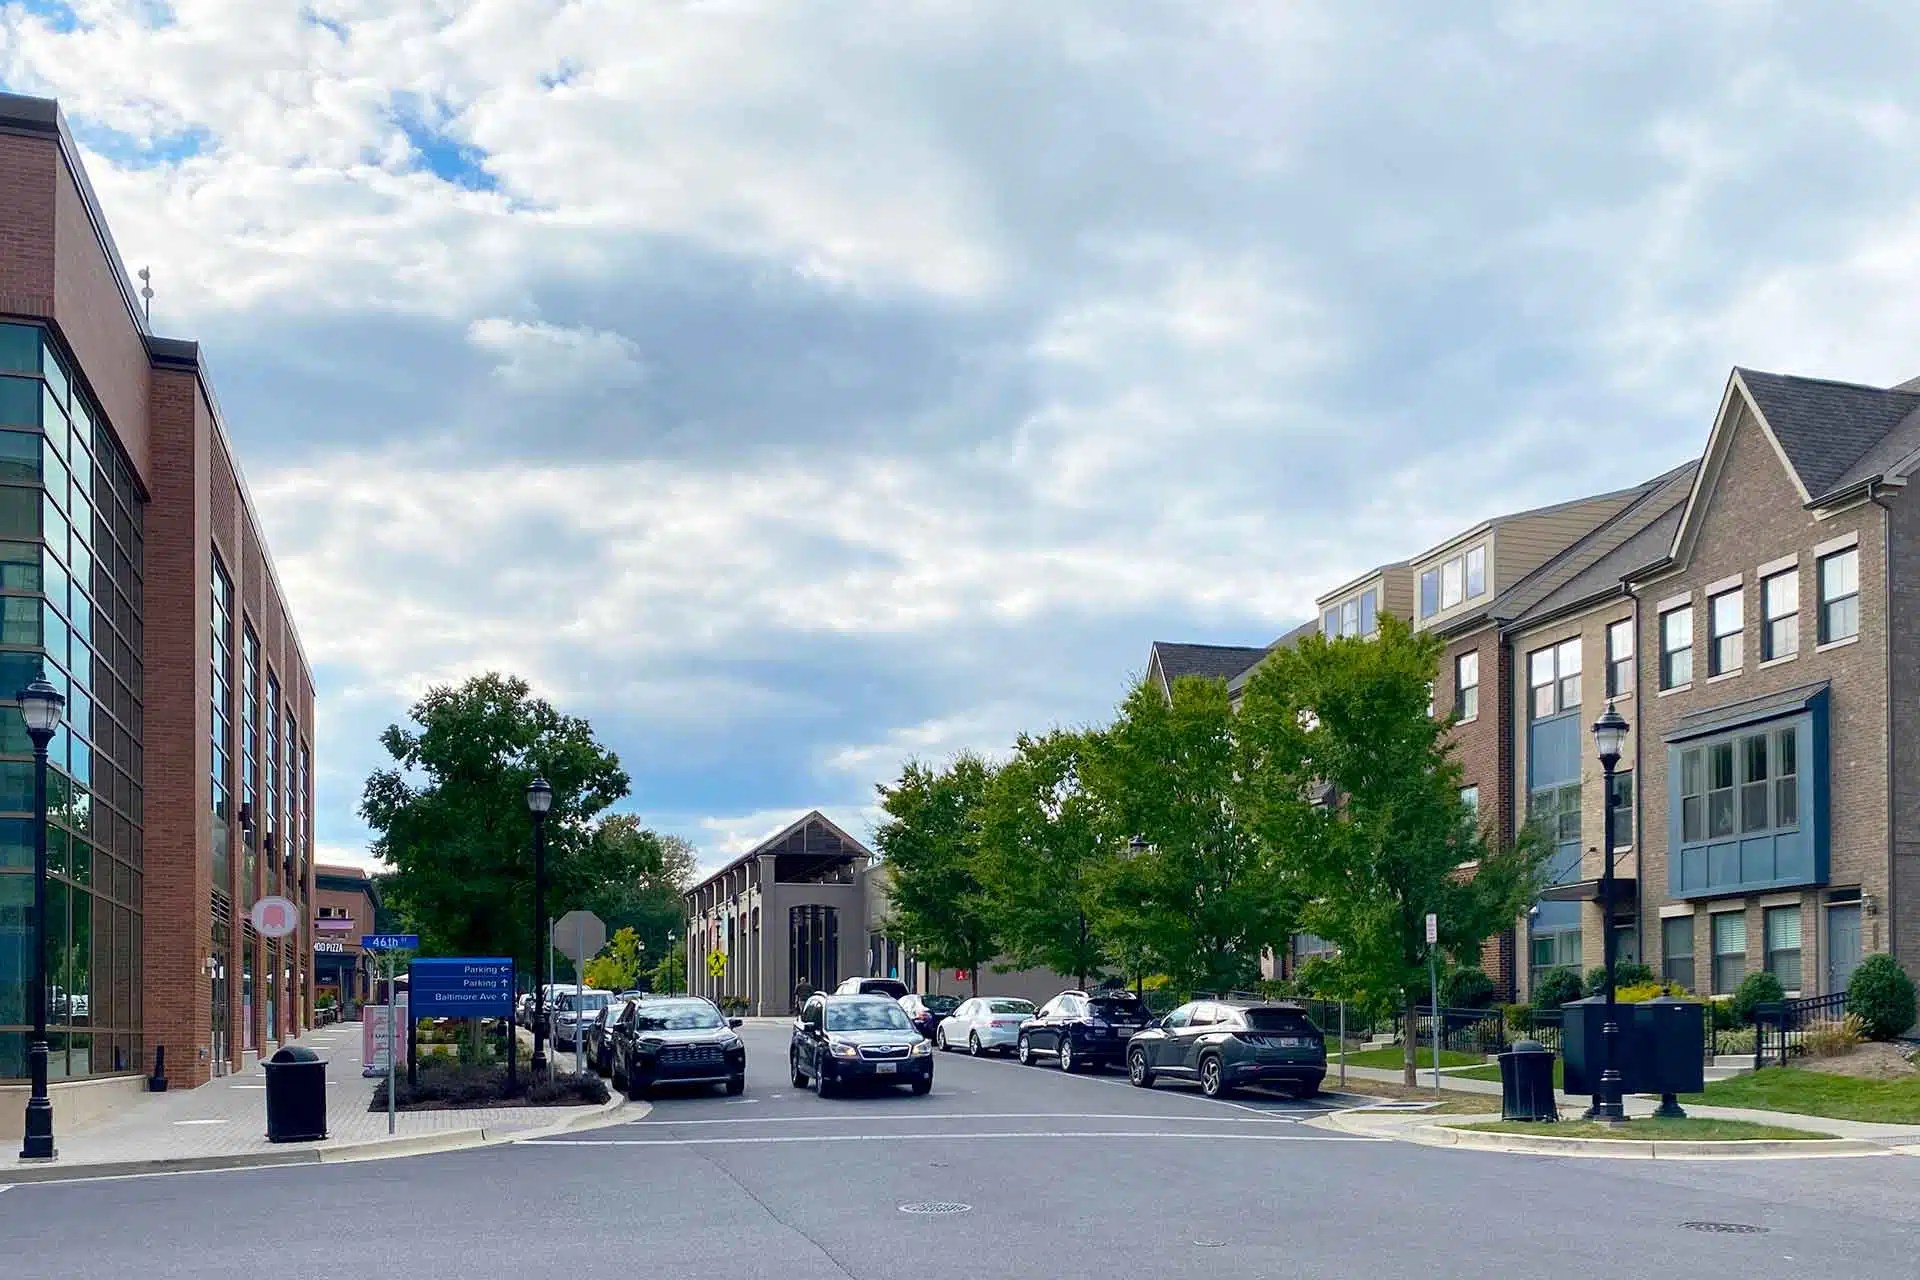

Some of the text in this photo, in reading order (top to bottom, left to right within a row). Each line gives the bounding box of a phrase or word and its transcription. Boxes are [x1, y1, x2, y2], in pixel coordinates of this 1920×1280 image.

[372, 937, 399, 947] 46th
[326, 943, 343, 953] PIZZA
[464, 965, 498, 975] Parking
[463, 979, 497, 988] Parking
[435, 992, 497, 1001] Baltimore Ave
